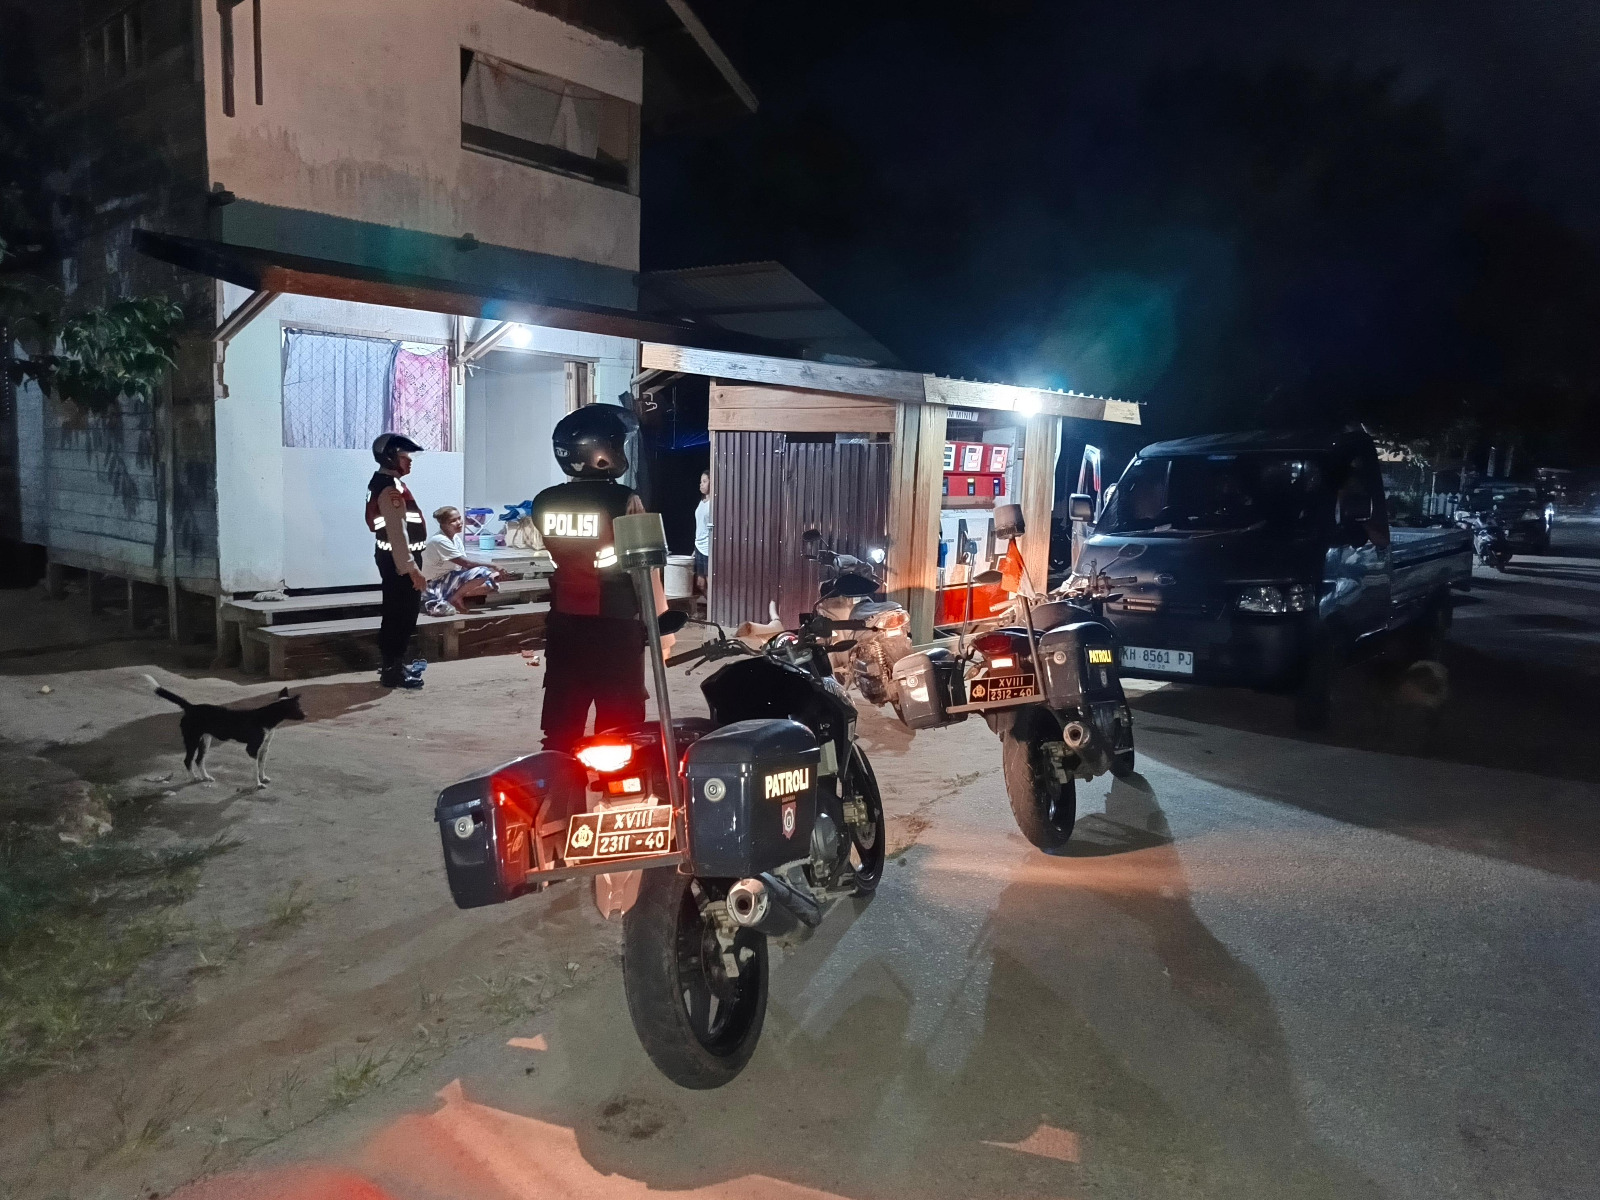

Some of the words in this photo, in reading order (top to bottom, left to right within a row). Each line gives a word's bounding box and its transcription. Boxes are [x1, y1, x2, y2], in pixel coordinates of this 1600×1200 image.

[956, 411, 971, 419] MINI
[544, 513, 599, 537] POLISI
[1089, 649, 1112, 663] PATROLI
[1122, 648, 1136, 660] KH
[1143, 650, 1170, 663] 8561
[1178, 653, 1192, 665] PJ
[999, 676, 1024, 688] XVIII
[765, 767, 809, 799] PATROLI
[613, 809, 654, 830] XVIII
